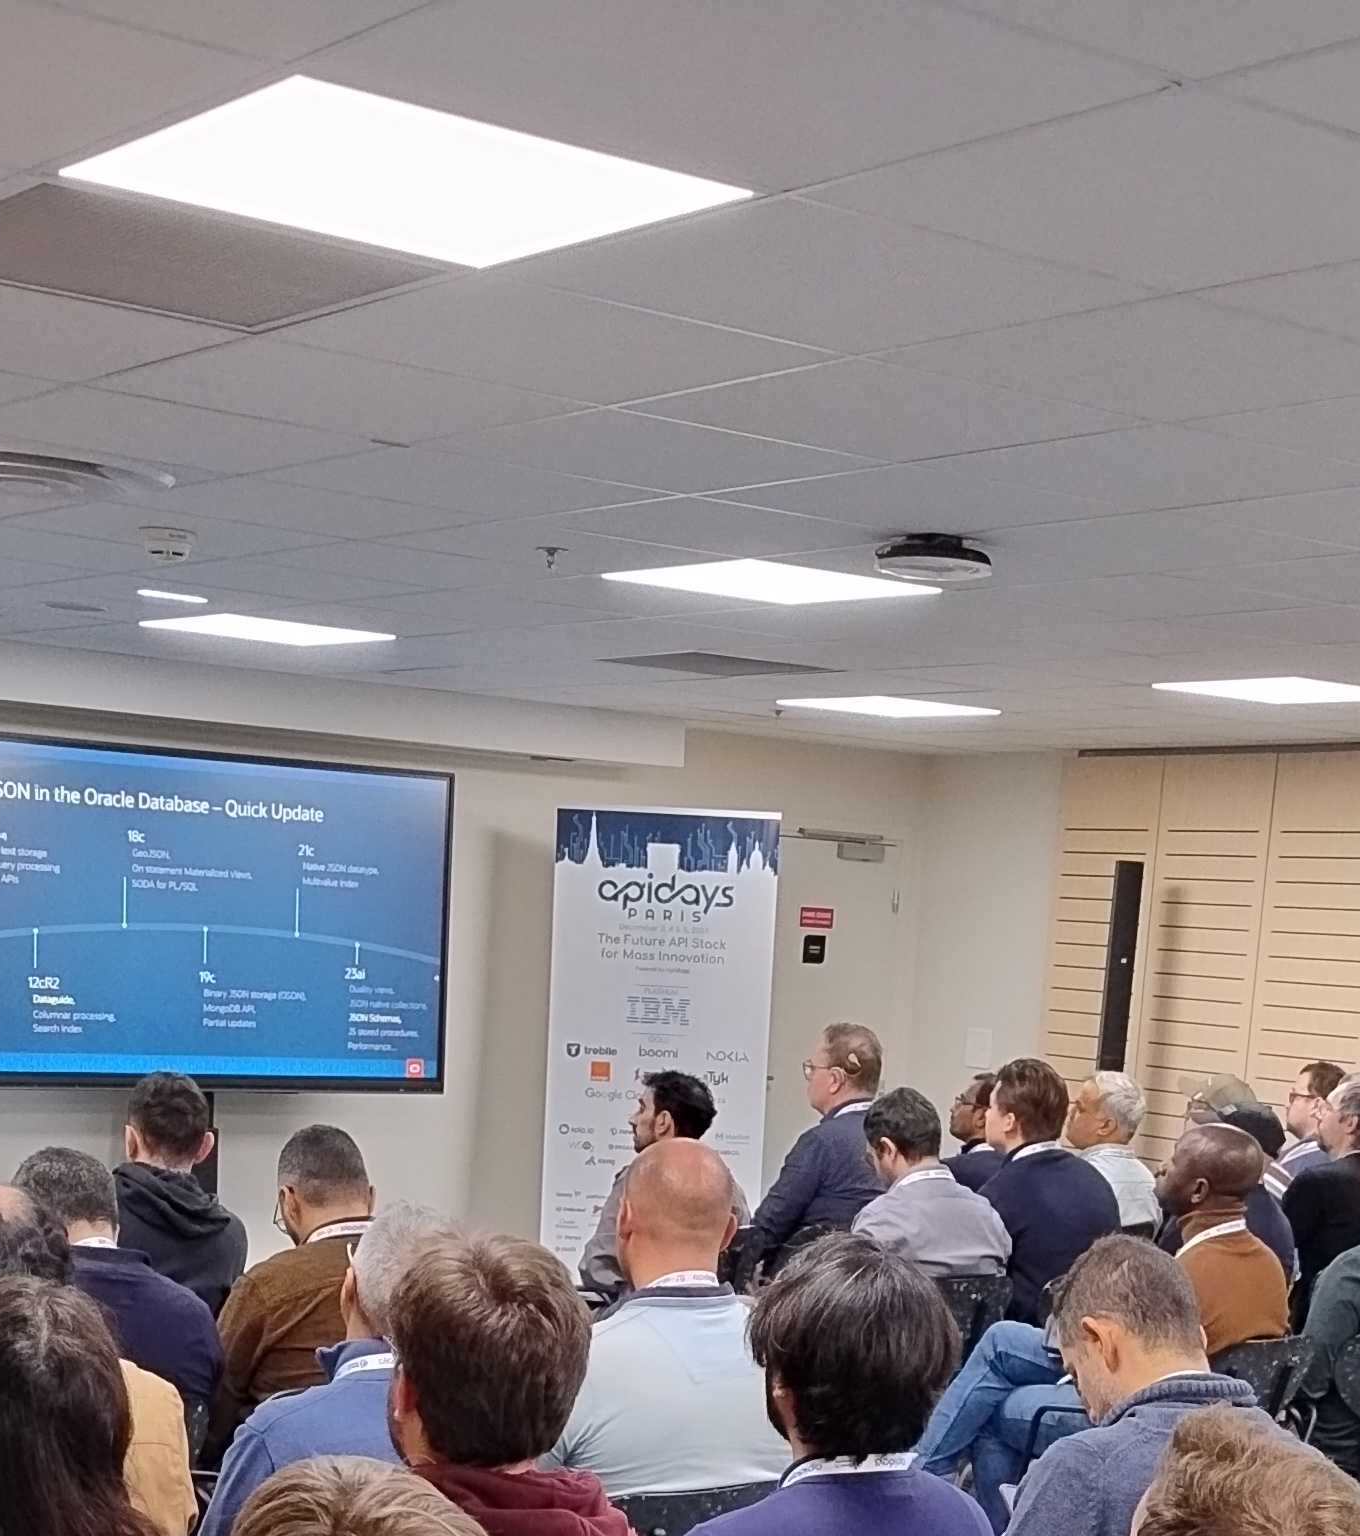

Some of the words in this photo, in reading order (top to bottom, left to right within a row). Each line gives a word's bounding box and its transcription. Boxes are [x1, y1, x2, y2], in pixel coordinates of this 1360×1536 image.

[34, 783, 50, 801] in
[54, 786, 81, 804] the
[84, 787, 135, 809] Oracle
[139, 791, 210, 814] Database
[225, 799, 268, 819] Quick
[271, 803, 325, 823] Update
[127, 830, 146, 843] 18c
[298, 844, 315, 857] 21c
[598, 872, 734, 915] apidays
[628, 908, 701, 923] PARIS
[598, 933, 621, 945] The
[623, 934, 666, 947] Future
[668, 936, 688, 949] API
[691, 937, 727, 951] Stack
[601, 947, 619, 959] for
[623, 949, 656, 961] Mass
[658, 950, 725, 966] Innovation
[199, 971, 217, 984] 19c
[344, 967, 366, 980] 23ai
[28, 976, 60, 990] 12cR2
[203, 1003, 240, 1014] MongoDB
[626, 996, 690, 1026] IBM
[348, 1013, 368, 1022] JSON
[32, 1024, 60, 1033] Search
[639, 1044, 679, 1058] boomi
[706, 1050, 750, 1062] NOKIA
[707, 1070, 729, 1084] Tyk
